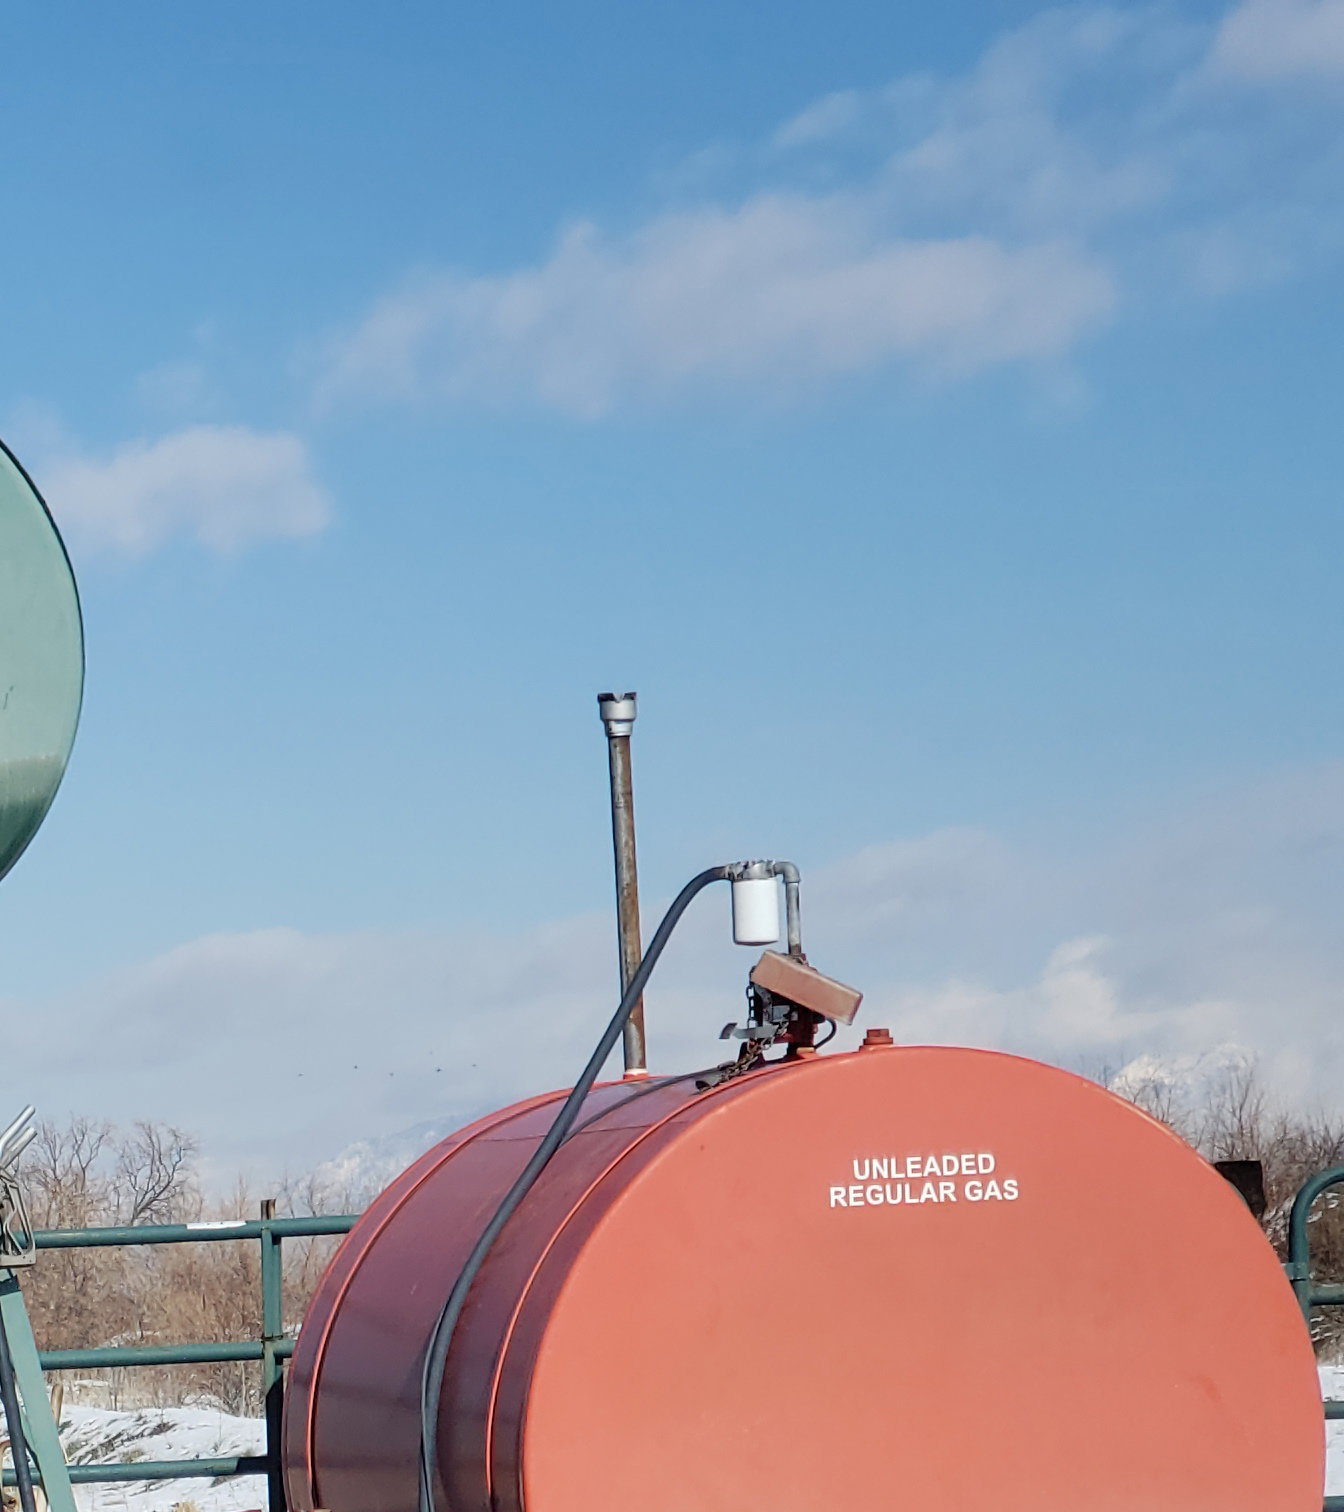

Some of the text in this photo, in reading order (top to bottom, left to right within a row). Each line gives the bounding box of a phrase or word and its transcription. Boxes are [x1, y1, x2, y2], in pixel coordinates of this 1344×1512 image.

[852, 1152, 997, 1181] UNLEADED
[828, 1178, 1020, 1208] REGULAR GAS
